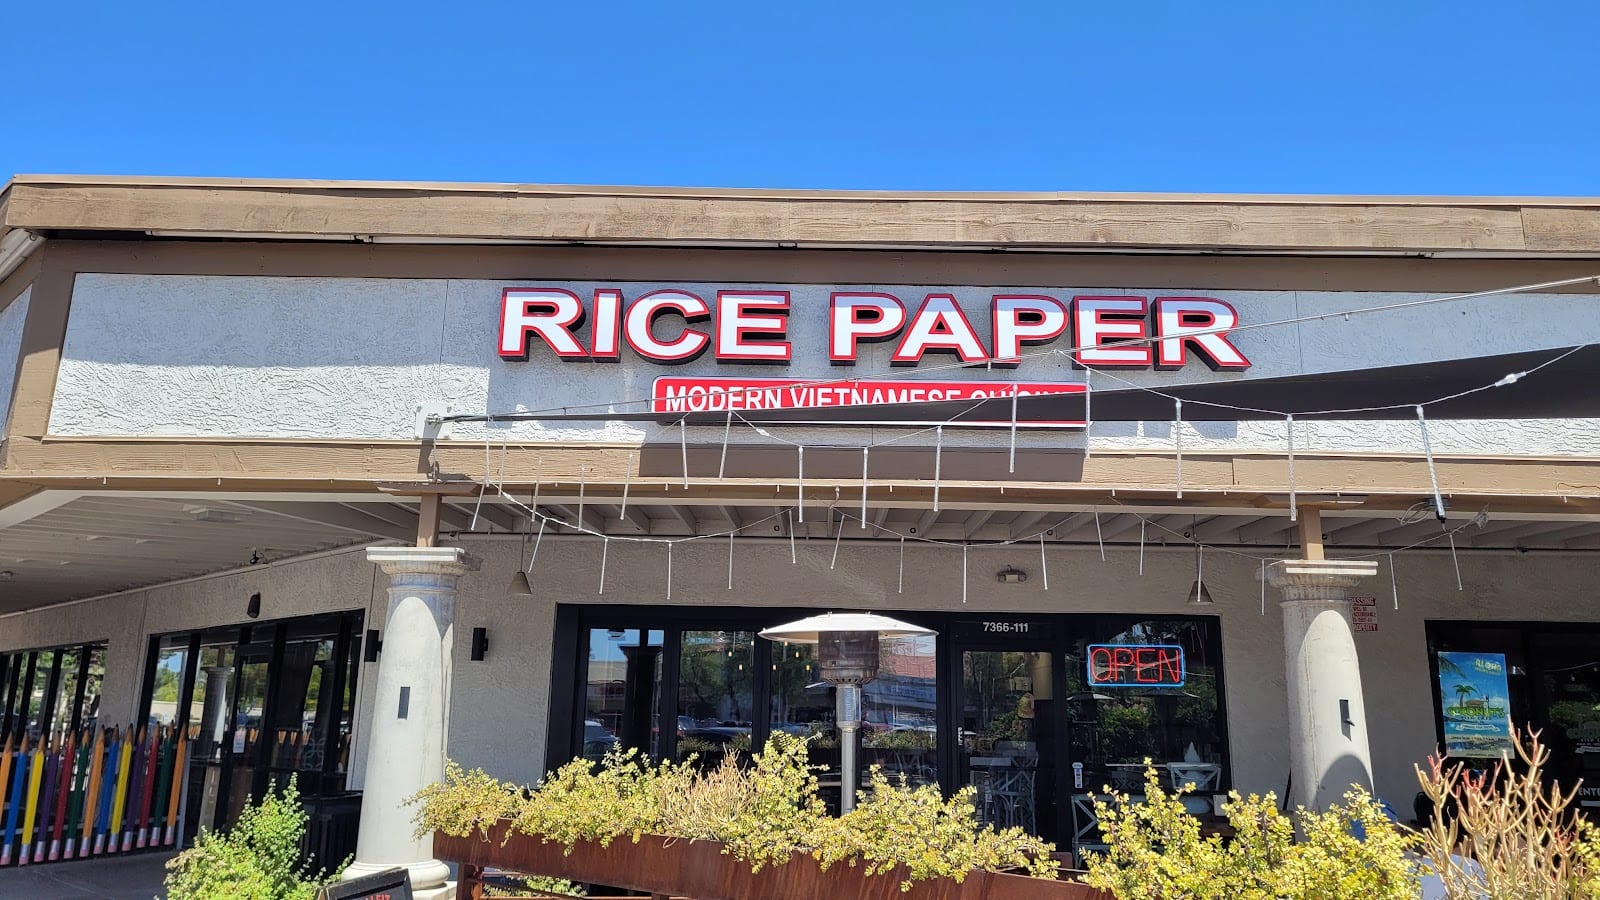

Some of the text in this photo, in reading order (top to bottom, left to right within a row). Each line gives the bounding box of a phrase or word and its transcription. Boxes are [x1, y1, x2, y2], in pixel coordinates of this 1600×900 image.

[498, 287, 1252, 371] RICE PAPER
[665, 385, 781, 412] MODERN
[982, 621, 1029, 633] 7366-111
[1091, 647, 1181, 683] OPEN
